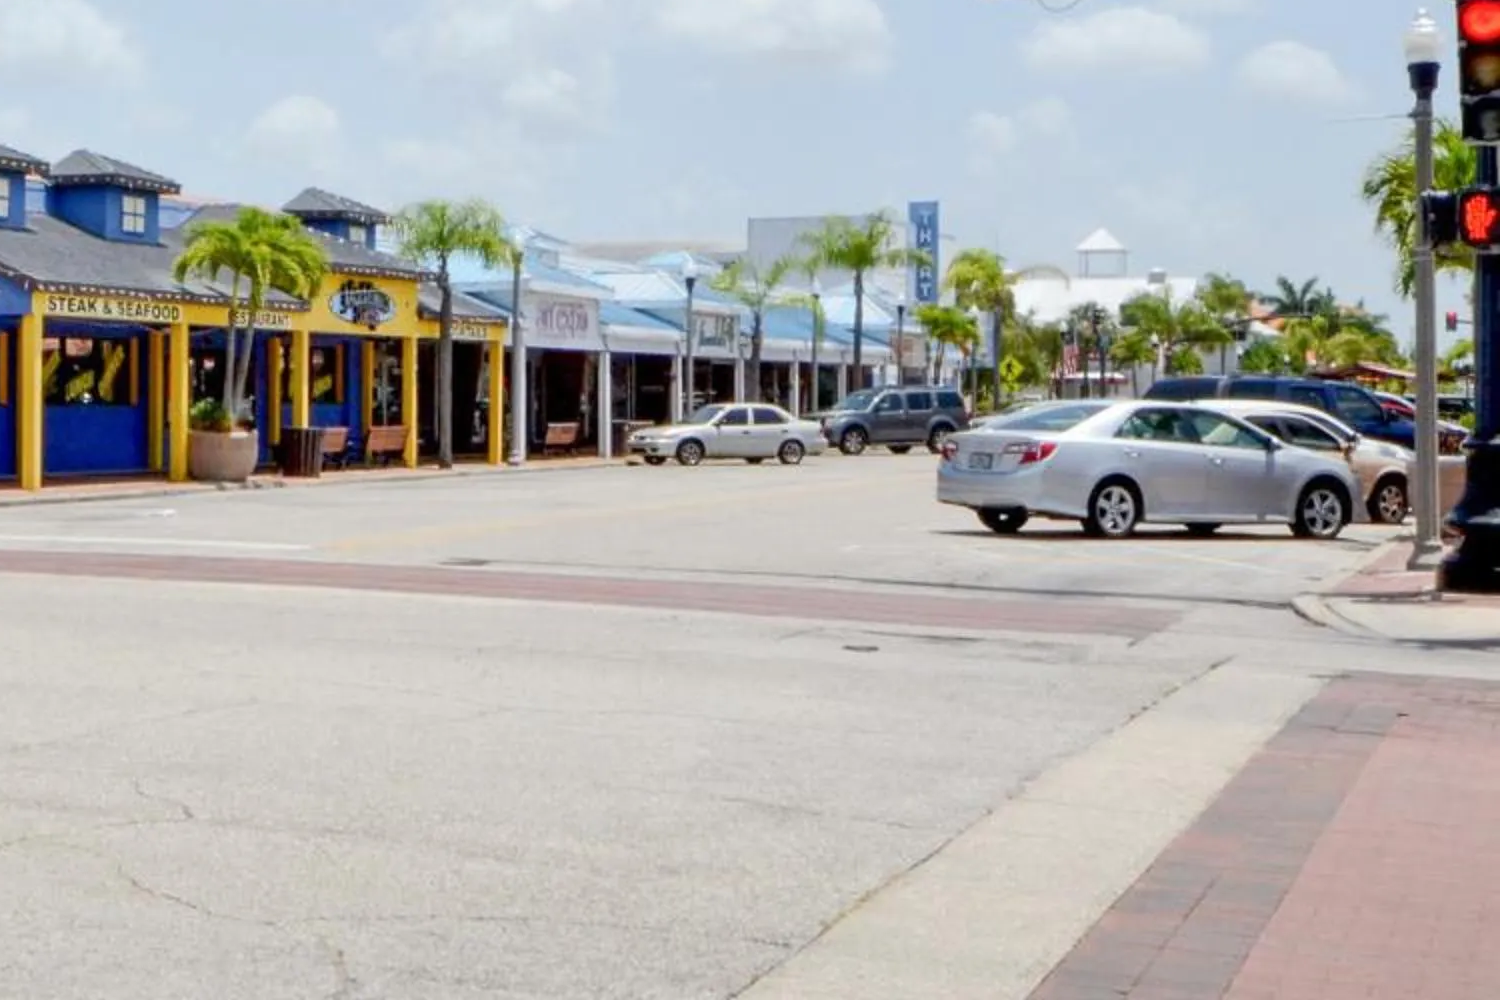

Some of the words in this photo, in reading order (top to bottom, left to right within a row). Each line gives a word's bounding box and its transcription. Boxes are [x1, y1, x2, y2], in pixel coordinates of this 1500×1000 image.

[48, 296, 97, 313] STEAK
[103, 301, 113, 314] &
[117, 301, 180, 321] SEAFOOD
